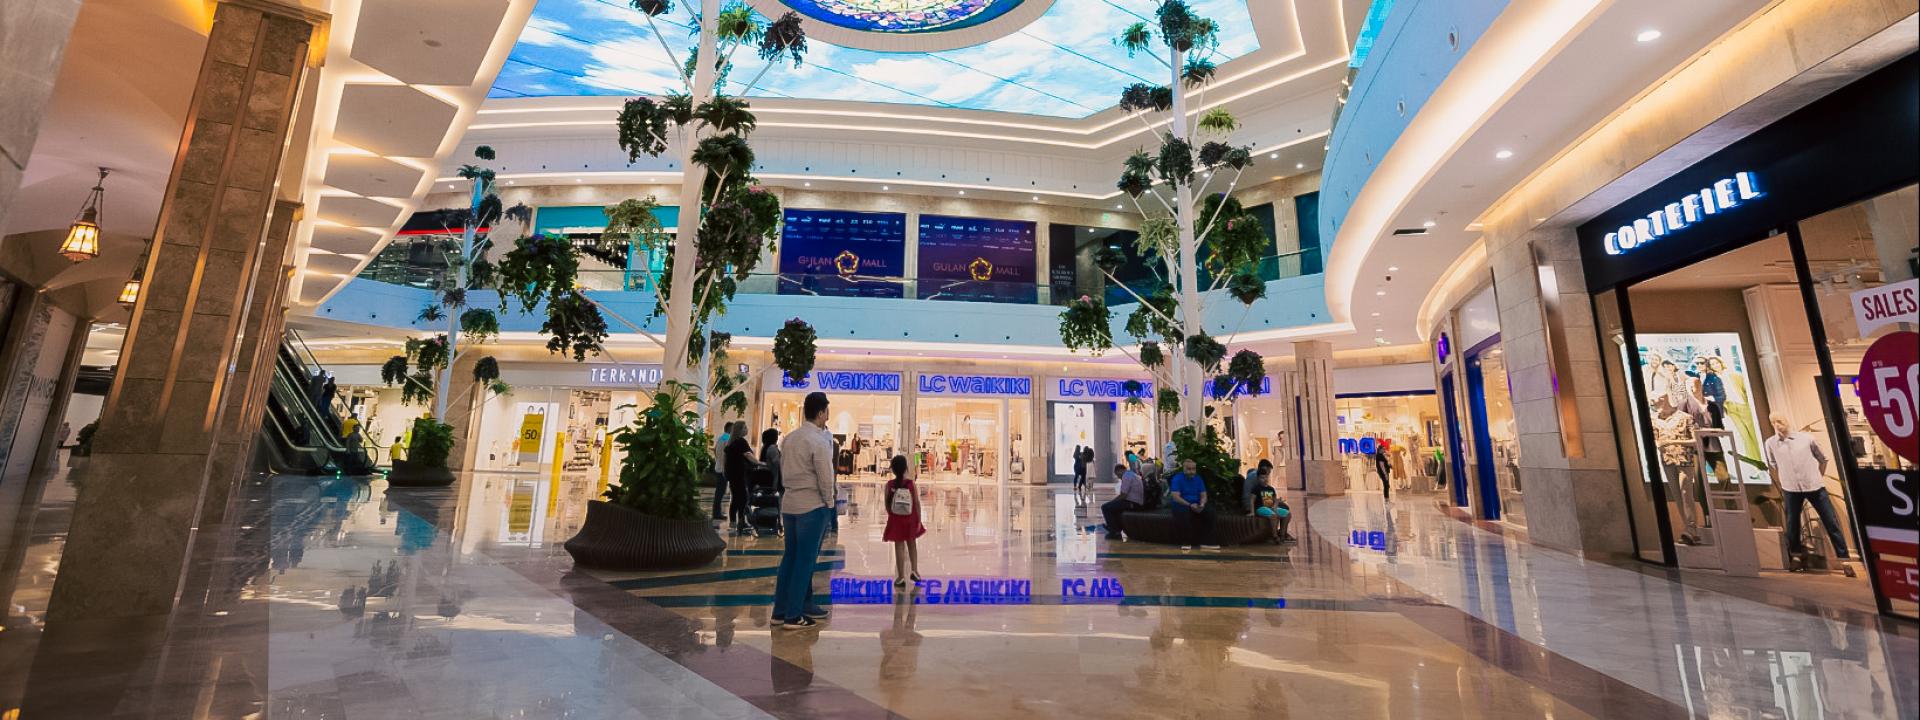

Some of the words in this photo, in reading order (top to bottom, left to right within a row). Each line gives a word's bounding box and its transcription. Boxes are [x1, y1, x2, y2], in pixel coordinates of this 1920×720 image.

[1603, 171, 1762, 255] CORTEFIEL
[862, 258, 887, 268] MALL
[933, 262, 967, 272] GULAN
[995, 266, 1021, 276] MALL
[1861, 287, 1918, 321] SALES
[591, 368, 663, 383] TERRANO
[919, 375, 946, 392] LC
[1059, 379, 1084, 397] LC
